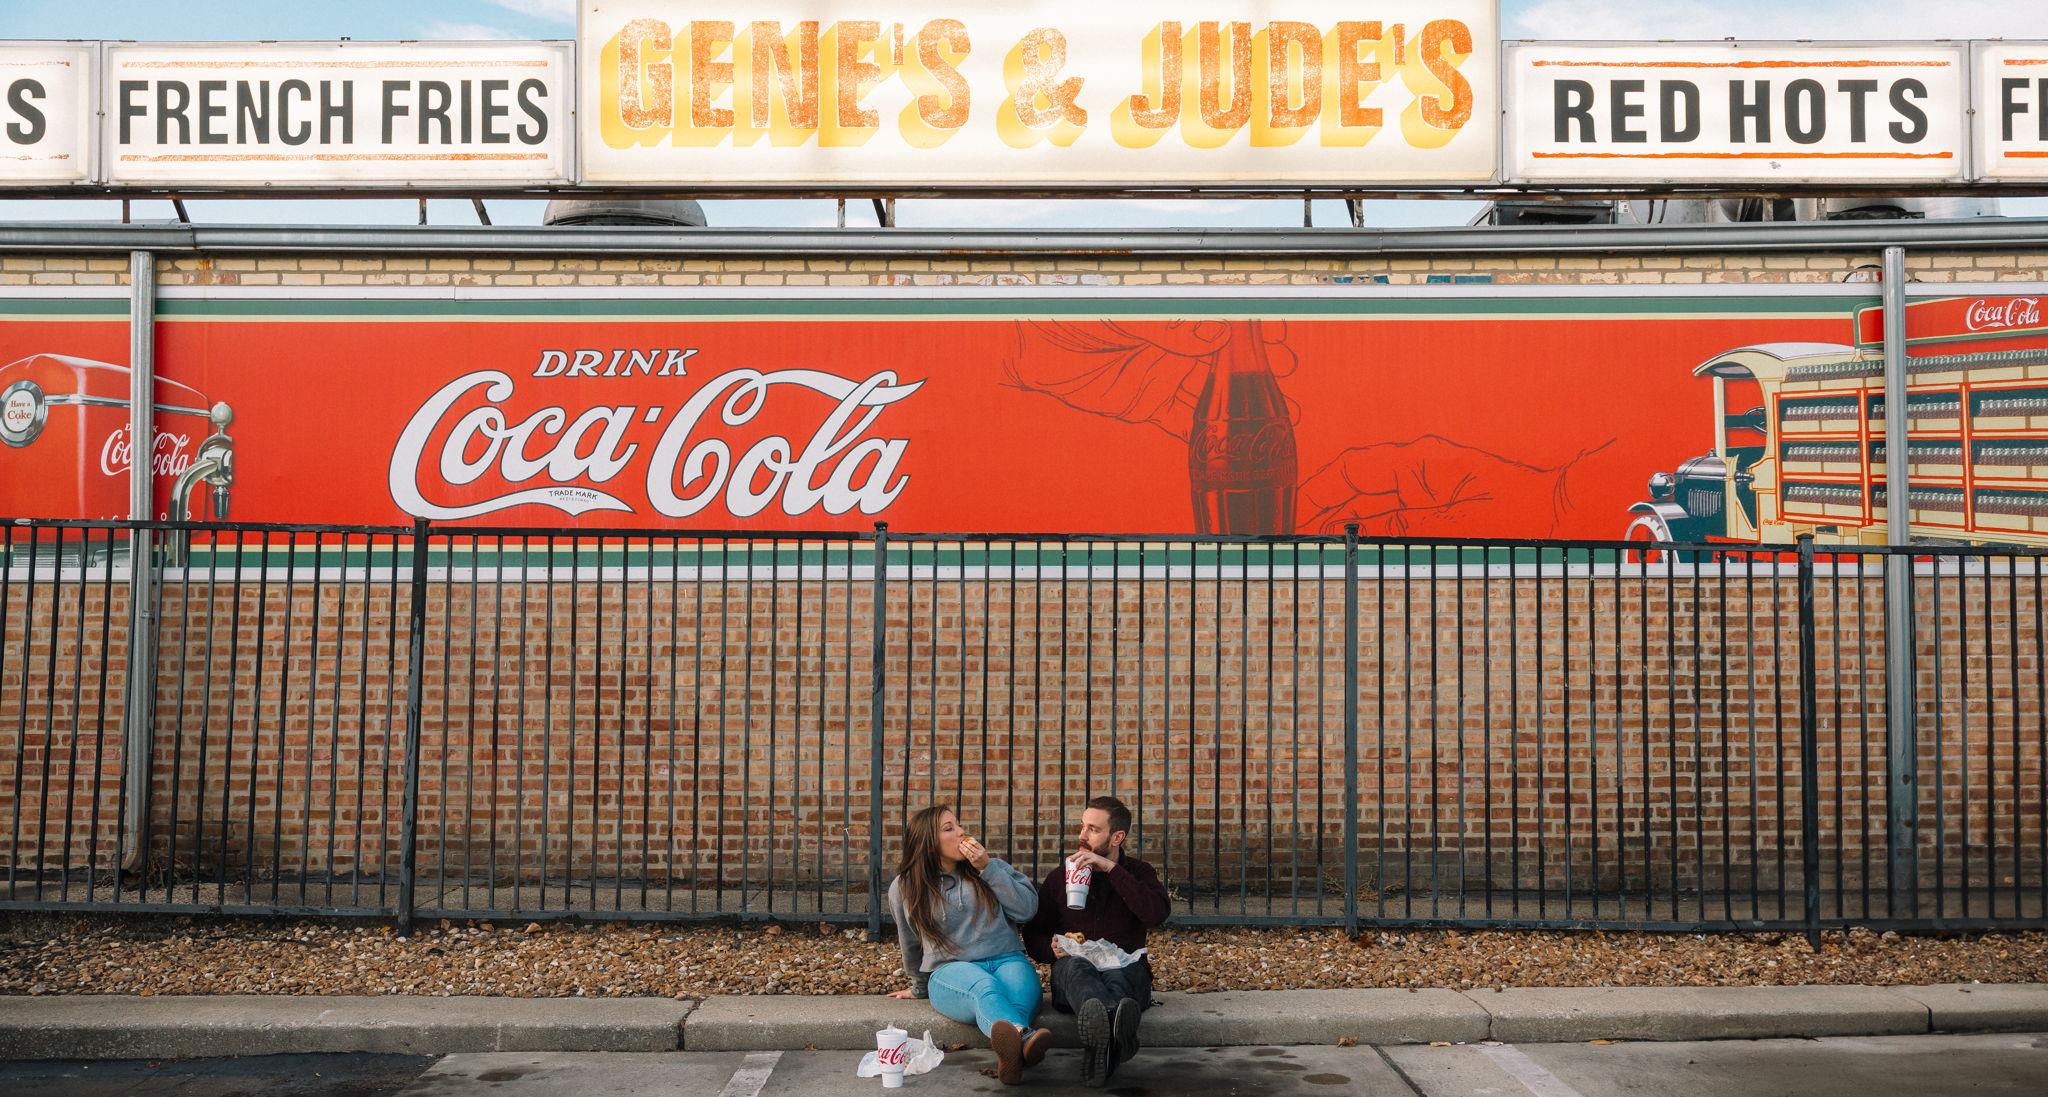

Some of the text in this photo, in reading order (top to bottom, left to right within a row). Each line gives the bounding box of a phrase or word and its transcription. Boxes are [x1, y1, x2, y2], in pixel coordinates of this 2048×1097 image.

[619, 19, 1475, 130] GENE'S & JUDE'S
[119, 78, 548, 146] FRENCH FRIES
[1553, 78, 1929, 144] RED HOTS
[532, 349, 700, 378] DRINK
[7, 410, 32, 420] Coke
[10, 400, 27, 408] Have
[388, 368, 927, 520] Coca-Cola
[548, 489, 574, 497] TRADE
[575, 490, 599, 500] MARK
